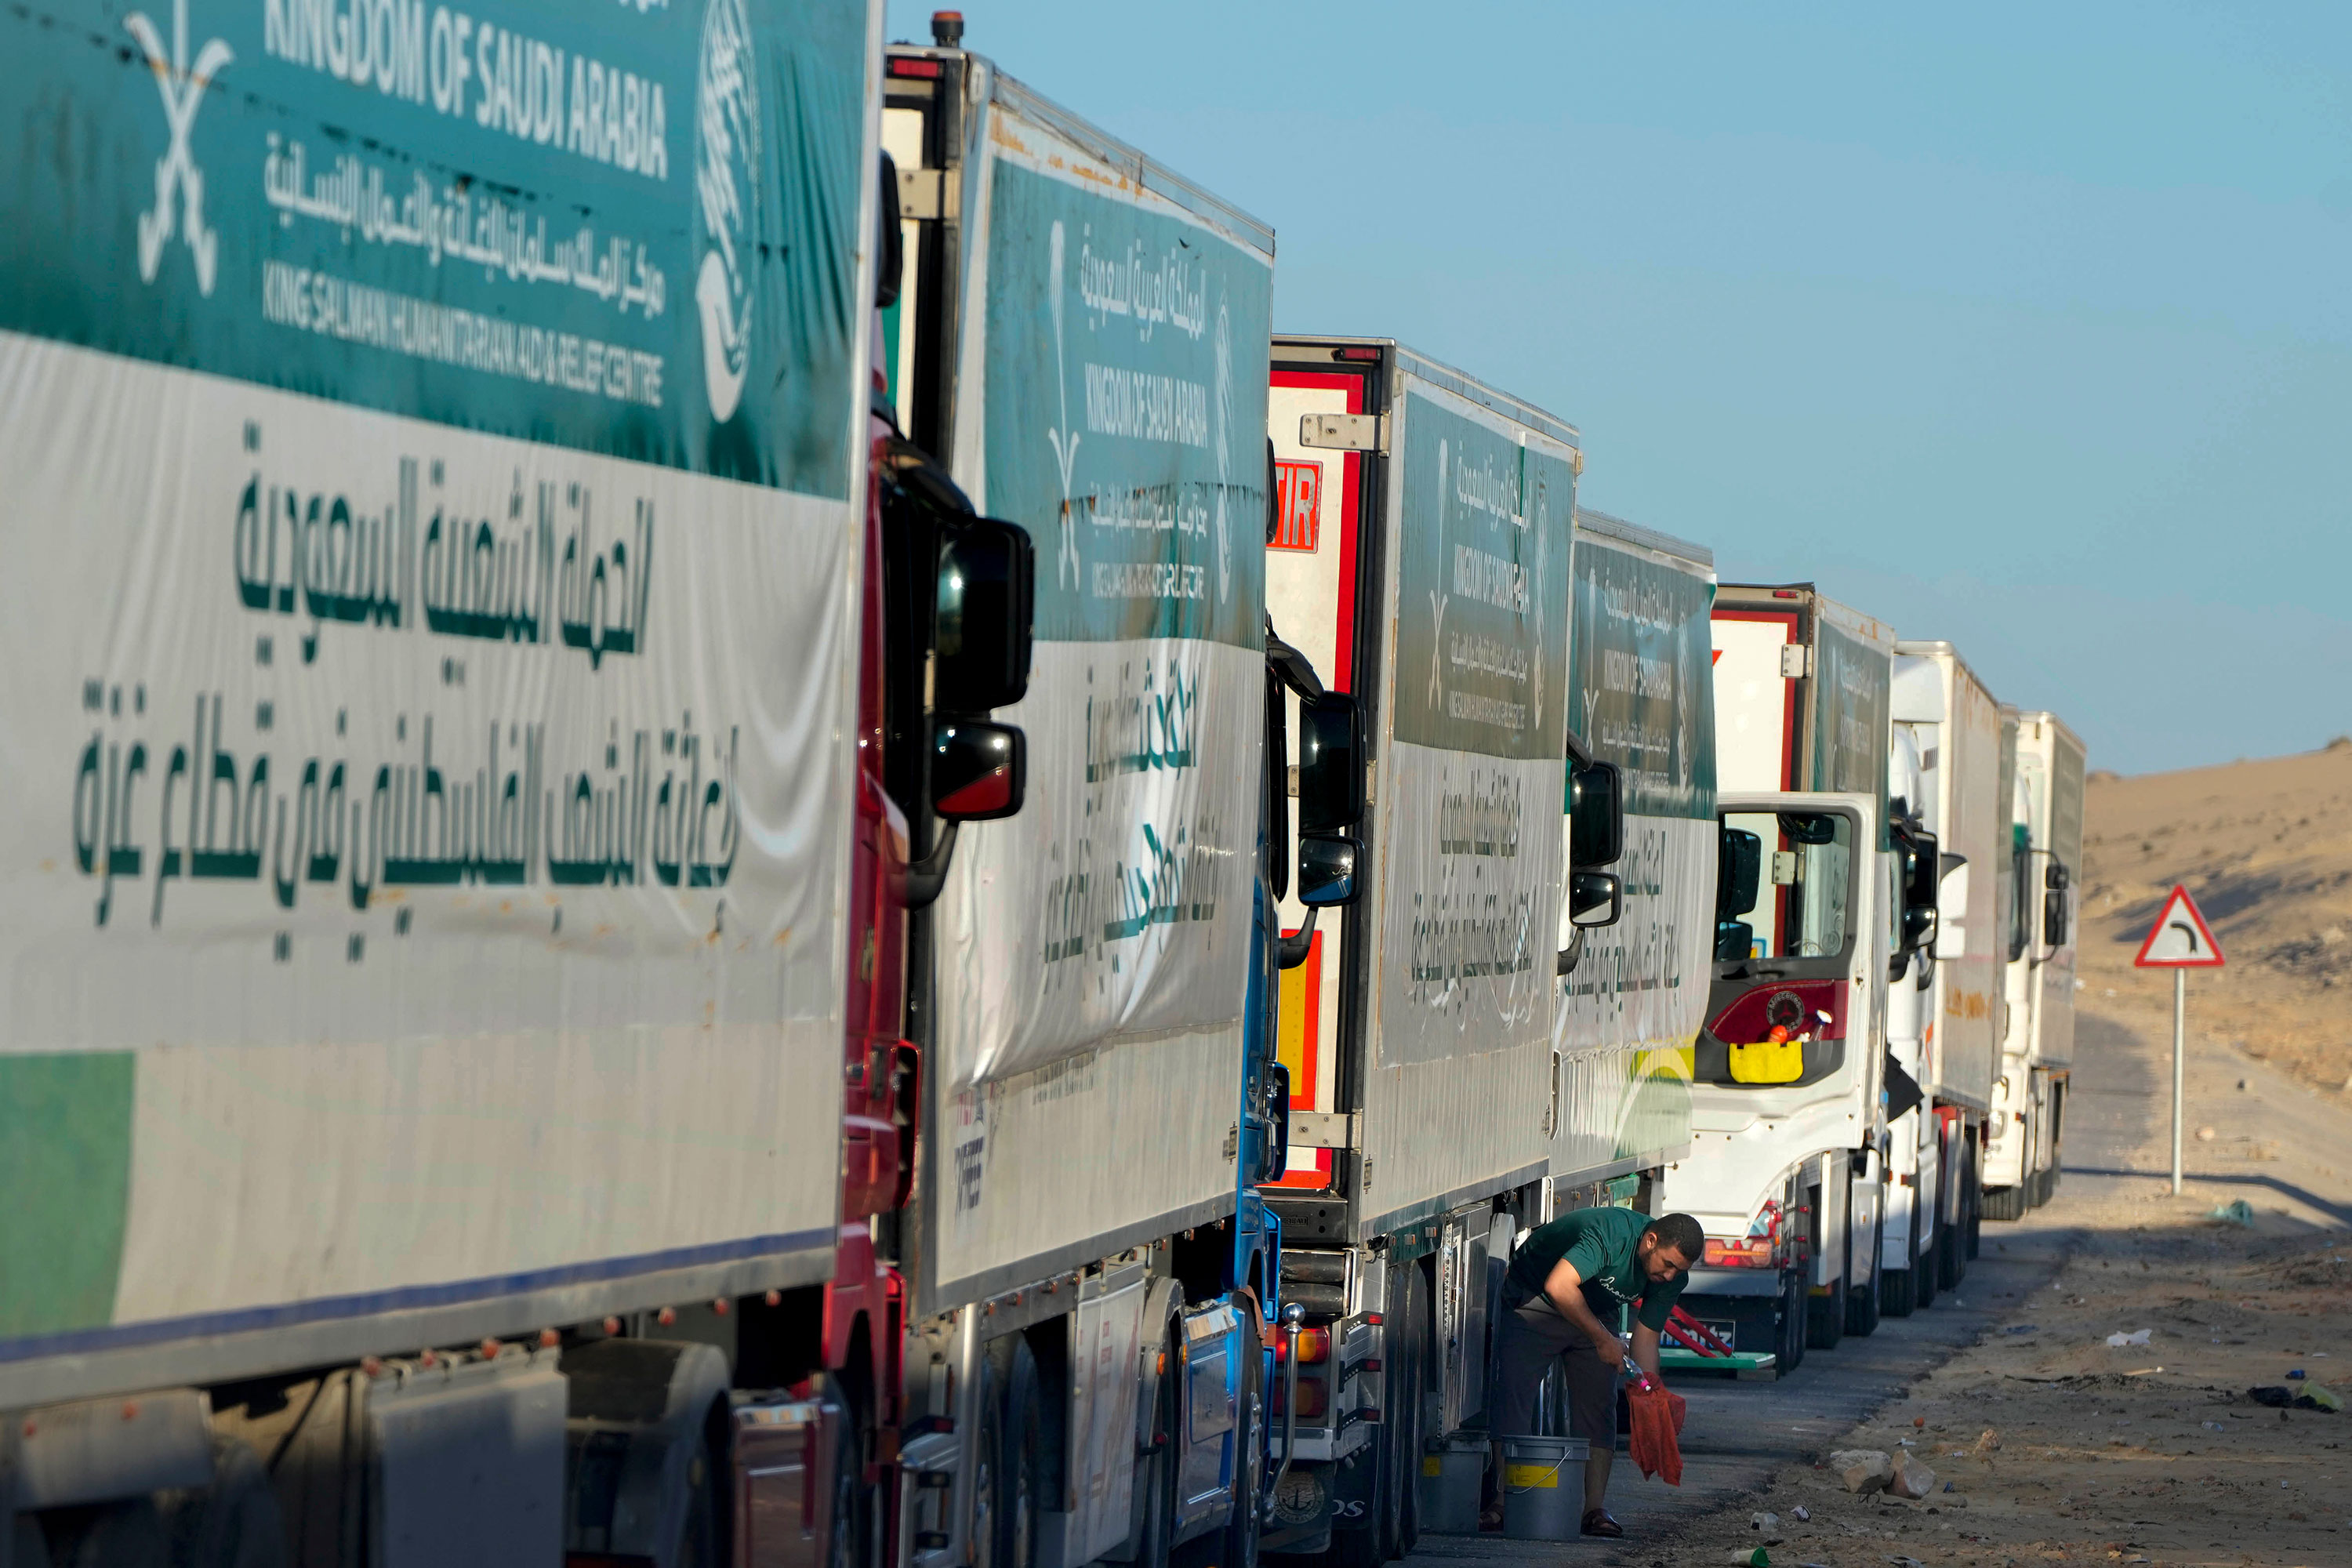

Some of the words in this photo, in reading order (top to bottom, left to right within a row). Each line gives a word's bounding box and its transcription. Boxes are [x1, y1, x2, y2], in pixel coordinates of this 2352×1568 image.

[265, 0, 426, 105] KINGDOM
[430, 5, 472, 118] OF
[475, 22, 565, 149] SAUDI
[568, 53, 668, 181] ARABIA
[1080, 223, 1133, 332] السعودية
[1133, 238, 1168, 343] العربية
[1169, 246, 1206, 341] المملكة
[263, 259, 312, 332] KING
[312, 272, 387, 350] SALMAN
[391, 291, 517, 377] HUMANITARIAN
[517, 321, 543, 383] AID
[604, 343, 663, 408] CENTRE
[1085, 362, 1133, 438] KINGDOM
[1134, 371, 1145, 439] OF
[1146, 373, 1176, 444] SAUDI
[1176, 378, 1207, 449] ARABIA
[234, 419, 416, 665] السعودية
[422, 459, 555, 687] الشعبية
[559, 481, 654, 670] الحملة
[1454, 543, 1483, 601] KINGDOM
[1483, 552, 1492, 604] OF
[1492, 555, 1510, 610] SAUDI
[1630, 654, 1639, 695] OF
